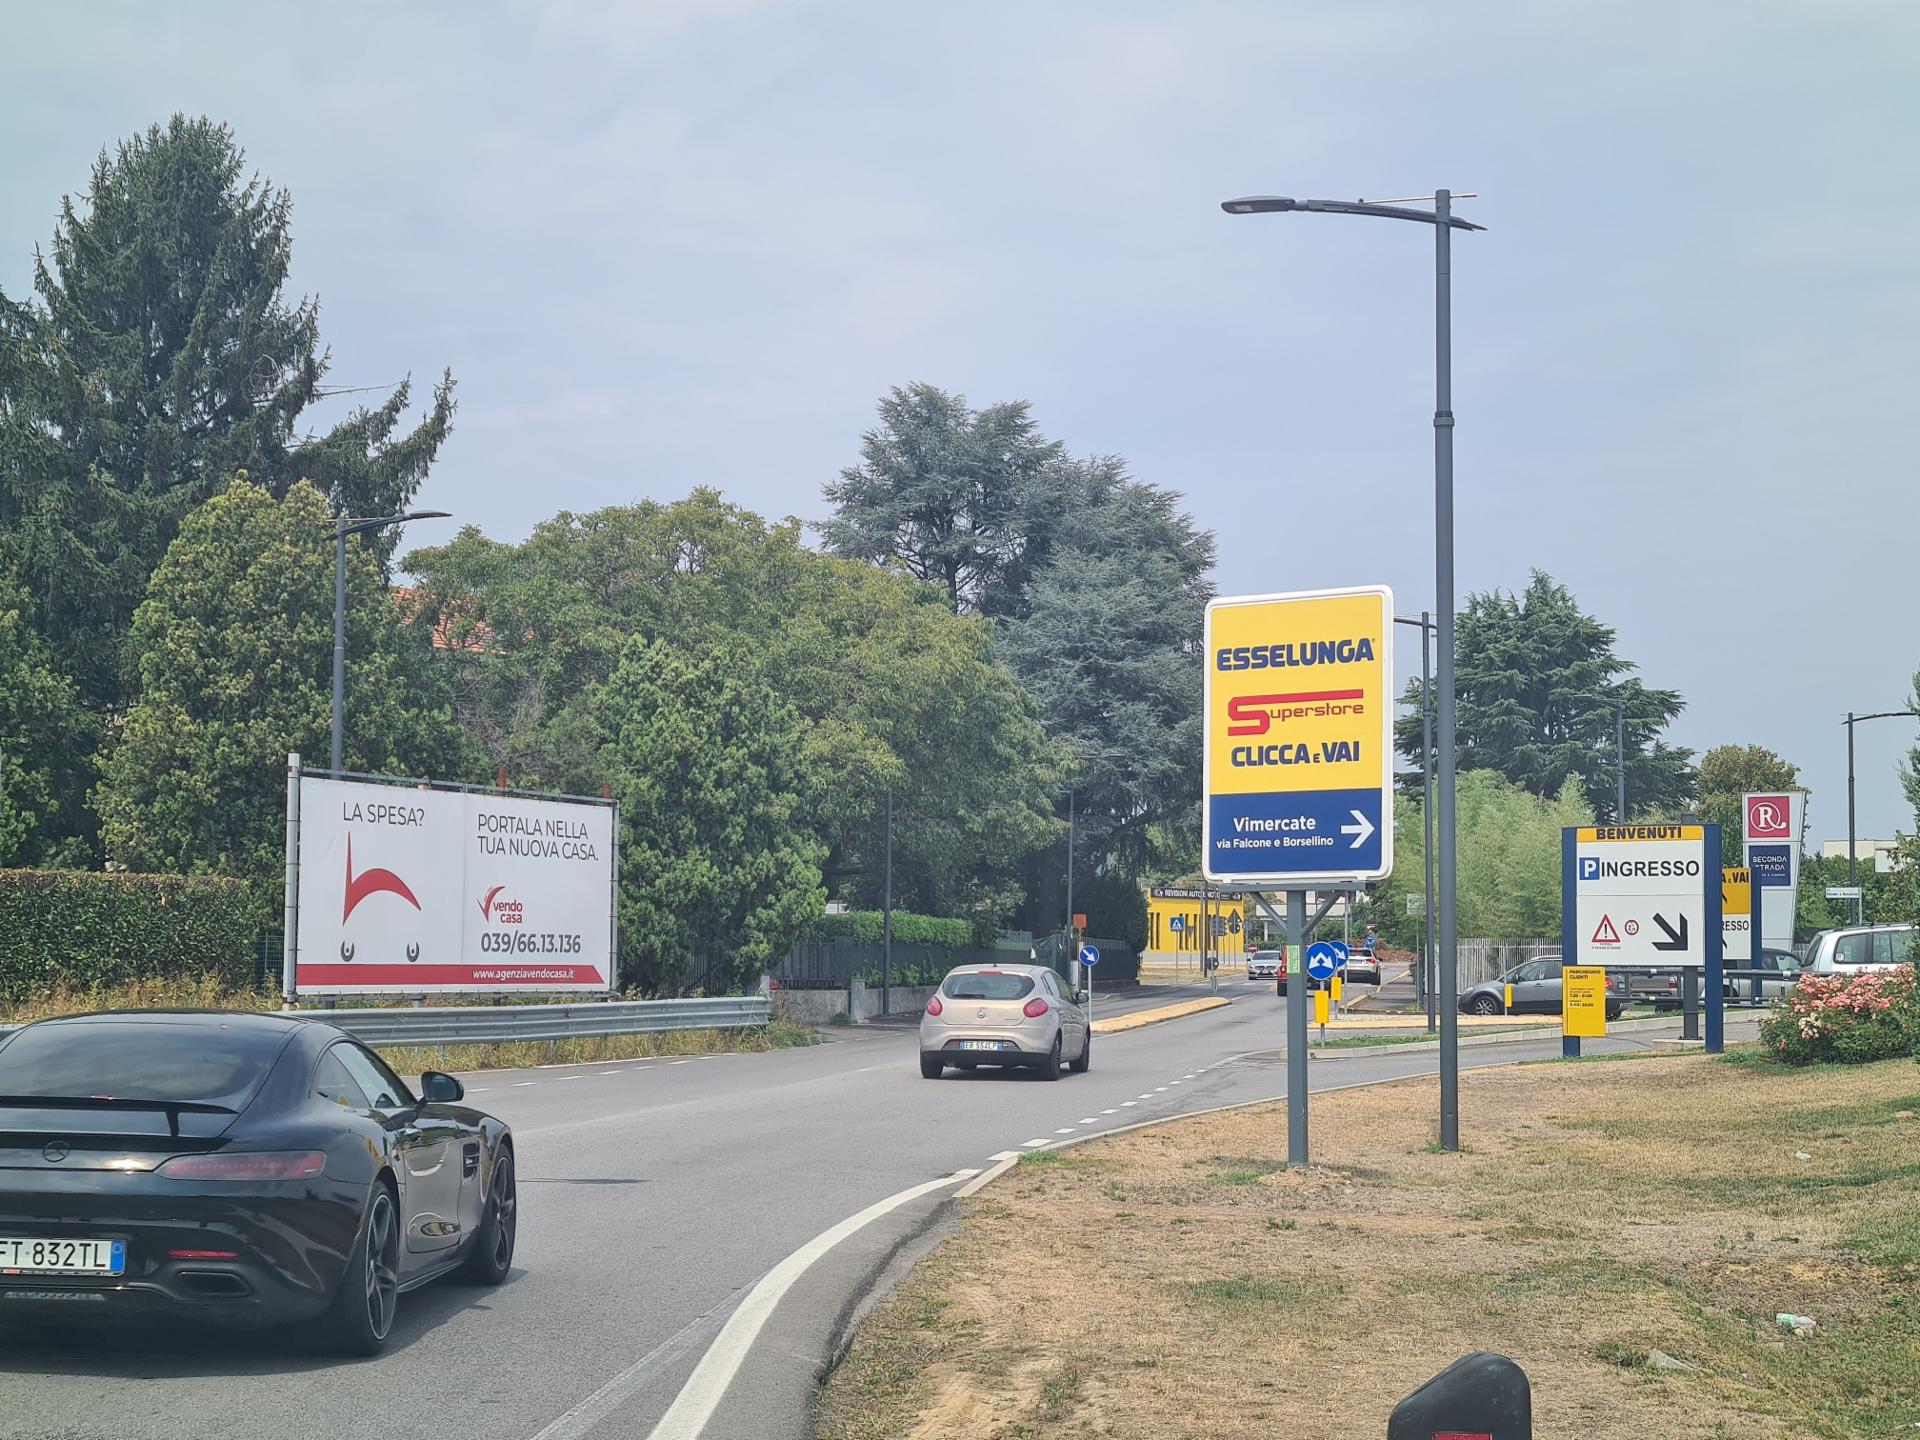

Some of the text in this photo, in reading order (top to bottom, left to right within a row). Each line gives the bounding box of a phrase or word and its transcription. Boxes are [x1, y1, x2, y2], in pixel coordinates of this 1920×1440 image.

[1216, 638, 1374, 671] ESSELUNGA
[1228, 689, 1364, 736] Superstore
[1231, 743, 1310, 767] CLICCA
[1321, 741, 1360, 762] VAI
[343, 802, 425, 827] LA SPESA?
[478, 814, 588, 839] PORTALA NELLA
[1233, 816, 1316, 832] Vimercate
[1596, 826, 1682, 840] BENVENUTI
[478, 836, 599, 861] TUA NUOVA CASA.
[1216, 836, 1334, 849] via Falcone e Borsellino
[1752, 855, 1787, 863] SECONDA
[1584, 860, 1700, 878] P INGRESSO
[1732, 871, 1749, 883] VAI
[493, 899, 523, 913] vendo
[500, 911, 523, 924] casa
[480, 930, 582, 954] 039/66.13.136
[472, 966, 574, 980] www.agenziavendocasa.it
[33, 1242, 106, 1268] 832TL
